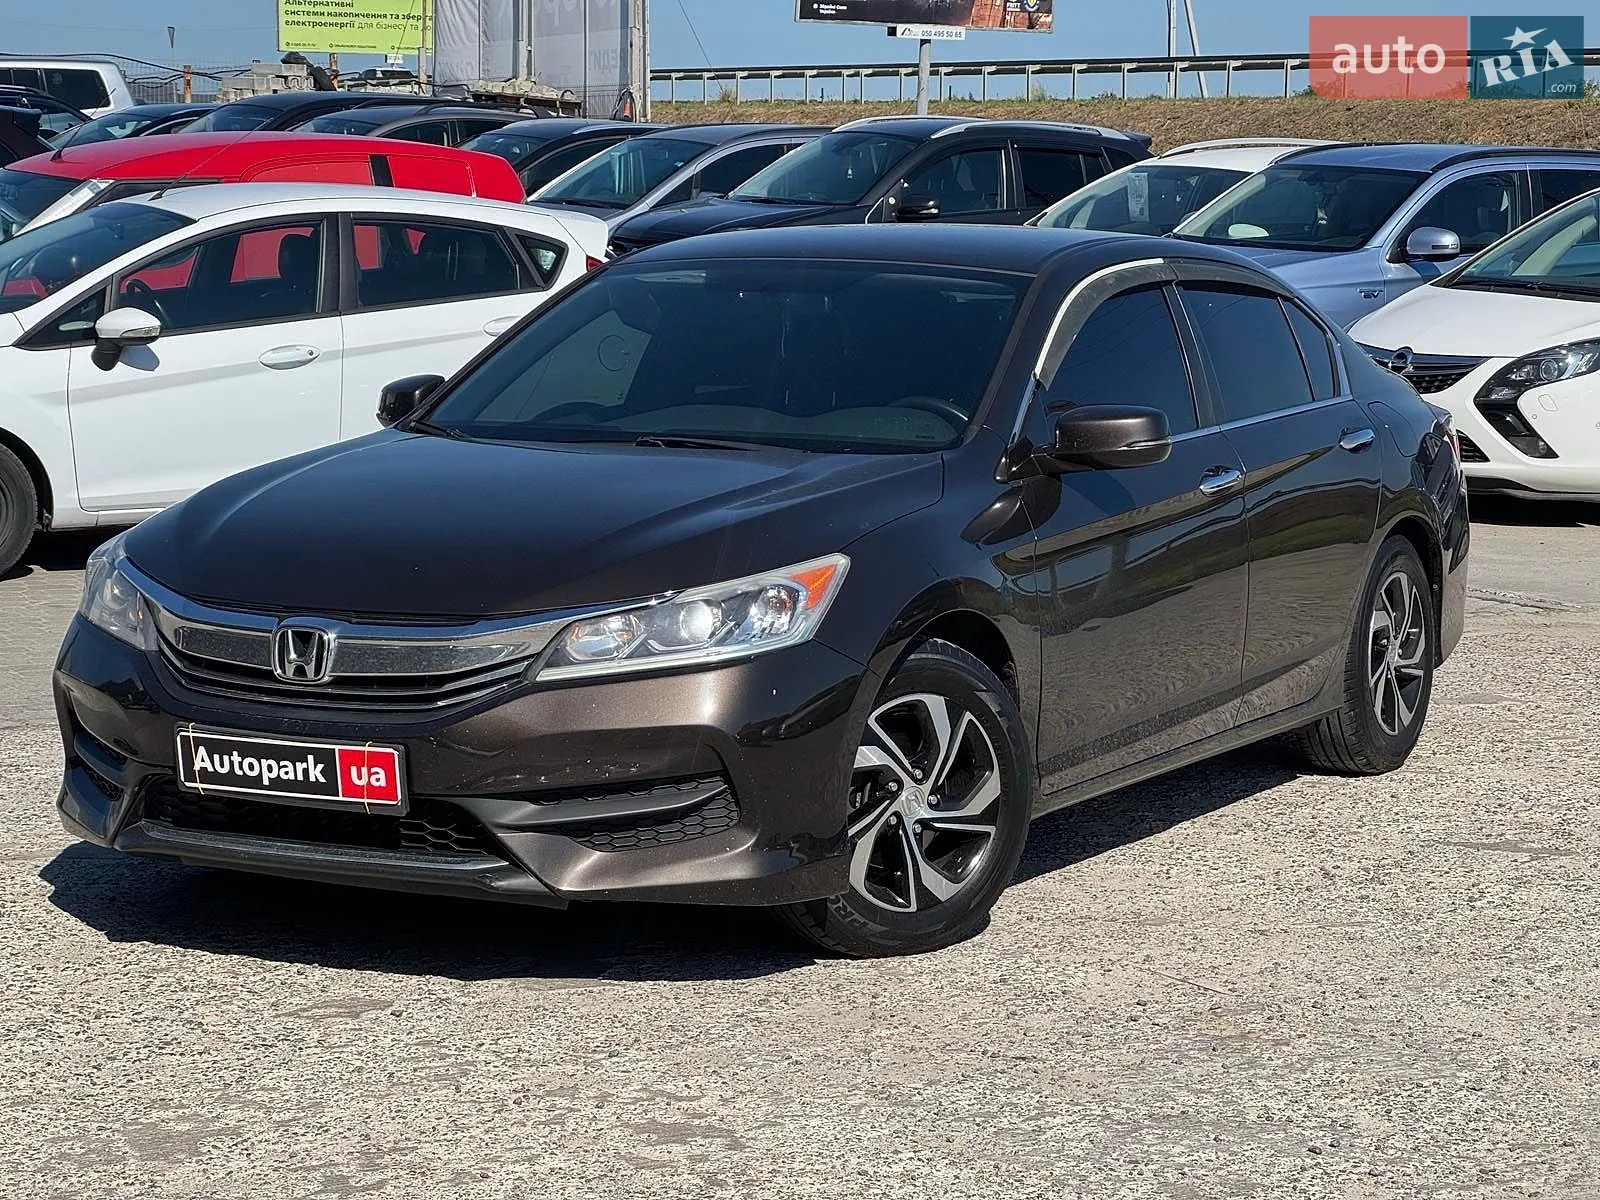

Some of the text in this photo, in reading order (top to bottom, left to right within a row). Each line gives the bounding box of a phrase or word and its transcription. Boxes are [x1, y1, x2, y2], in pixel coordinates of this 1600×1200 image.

[284, 0, 354, 8] Альтернативні
[284, 9, 326, 17] системи
[326, 11, 388, 19] накопичення
[284, 19, 355, 29] електроенергії
[357, 21, 374, 30] для
[409, 23, 419, 31] та
[193, 745, 387, 788] Autopark ua
